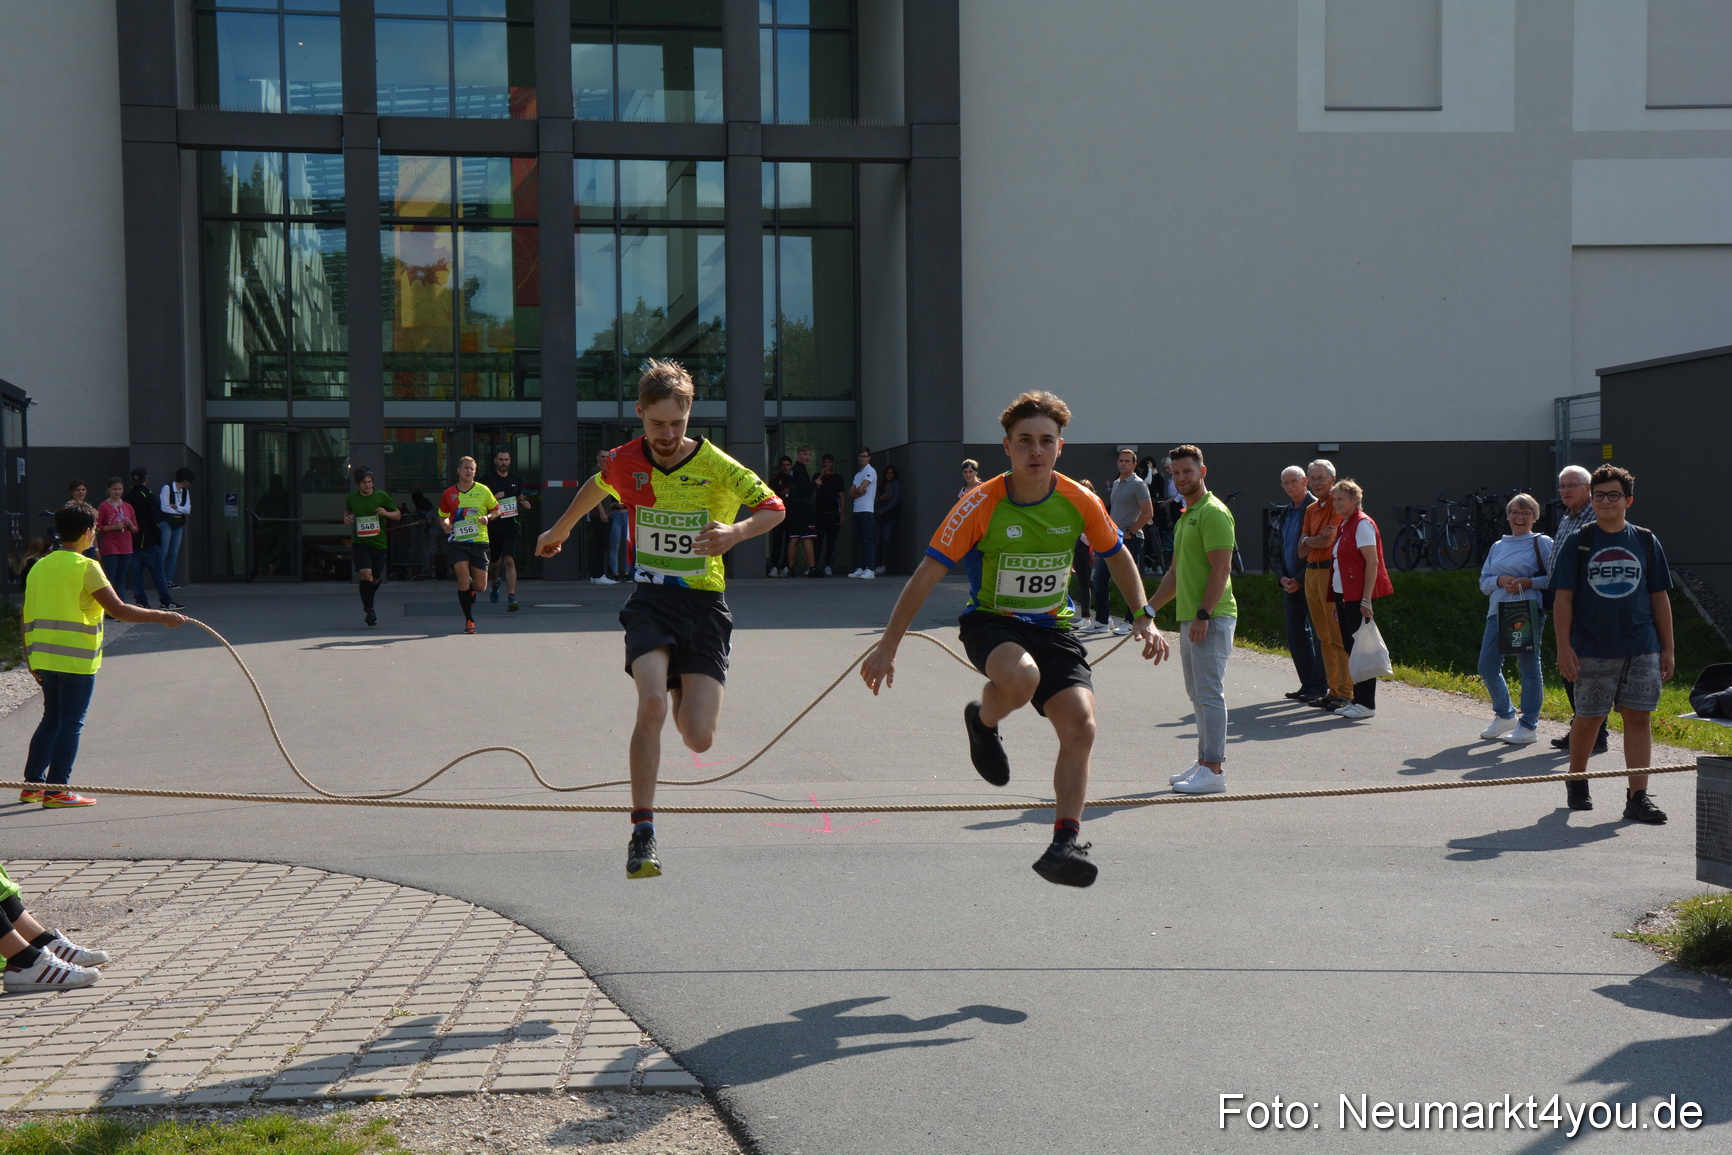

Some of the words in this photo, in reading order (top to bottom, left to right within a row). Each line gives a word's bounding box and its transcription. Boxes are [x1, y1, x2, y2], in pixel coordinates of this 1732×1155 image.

[640, 509, 704, 529] BOCK
[940, 488, 989, 547] BOCK
[360, 523, 375, 531] 548
[459, 526, 474, 534] 156
[650, 532, 693, 554] 159
[1004, 554, 1068, 570] BOCK
[1588, 566, 1640, 580] PEPSI
[1015, 574, 1056, 593] 189
